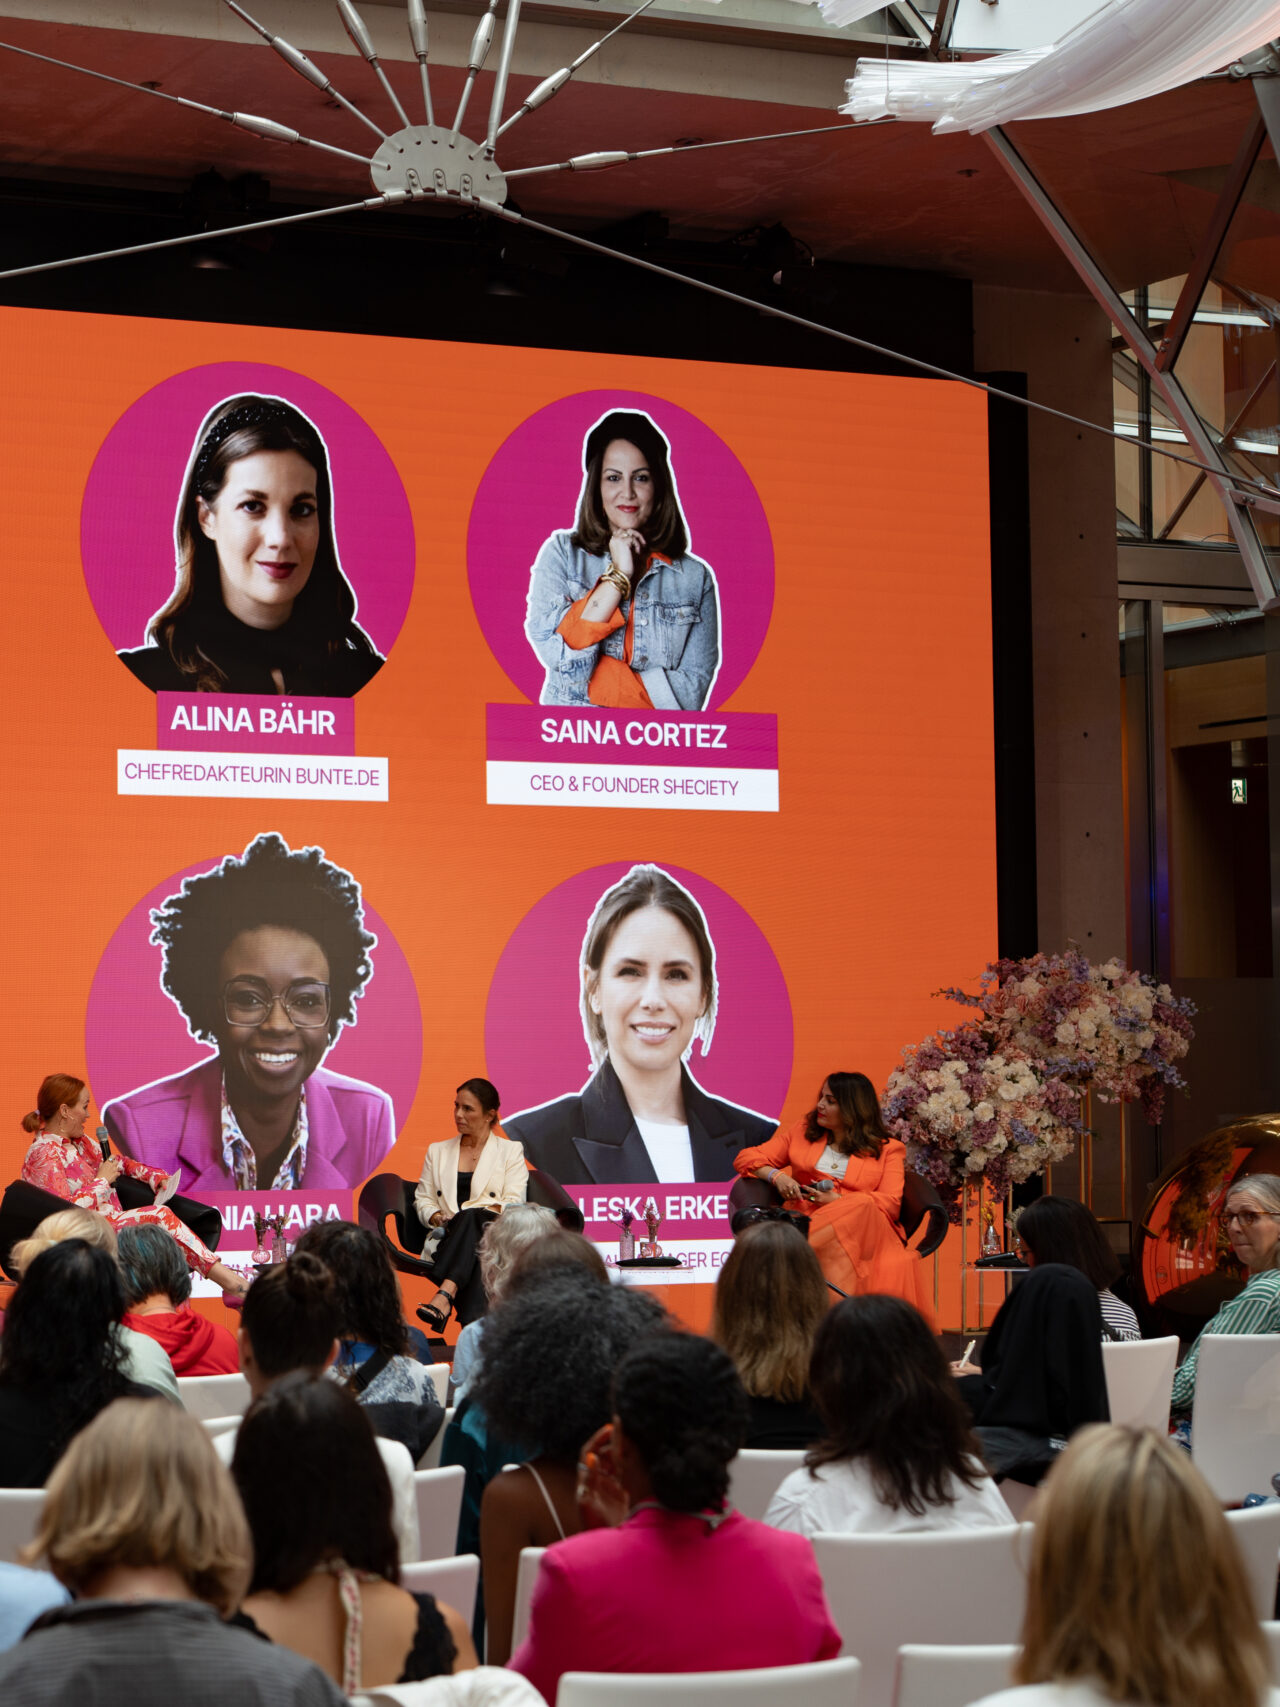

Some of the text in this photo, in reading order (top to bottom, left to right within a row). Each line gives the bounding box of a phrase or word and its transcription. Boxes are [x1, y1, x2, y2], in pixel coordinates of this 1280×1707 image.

[170, 702, 336, 736] ALINA BÄHR
[541, 718, 728, 749] SAINA CORTEZ
[124, 762, 380, 787] CHEFREDAKTEURIN BUNTE.DE
[530, 774, 739, 796] CEO & FOUNDER SHECIETY
